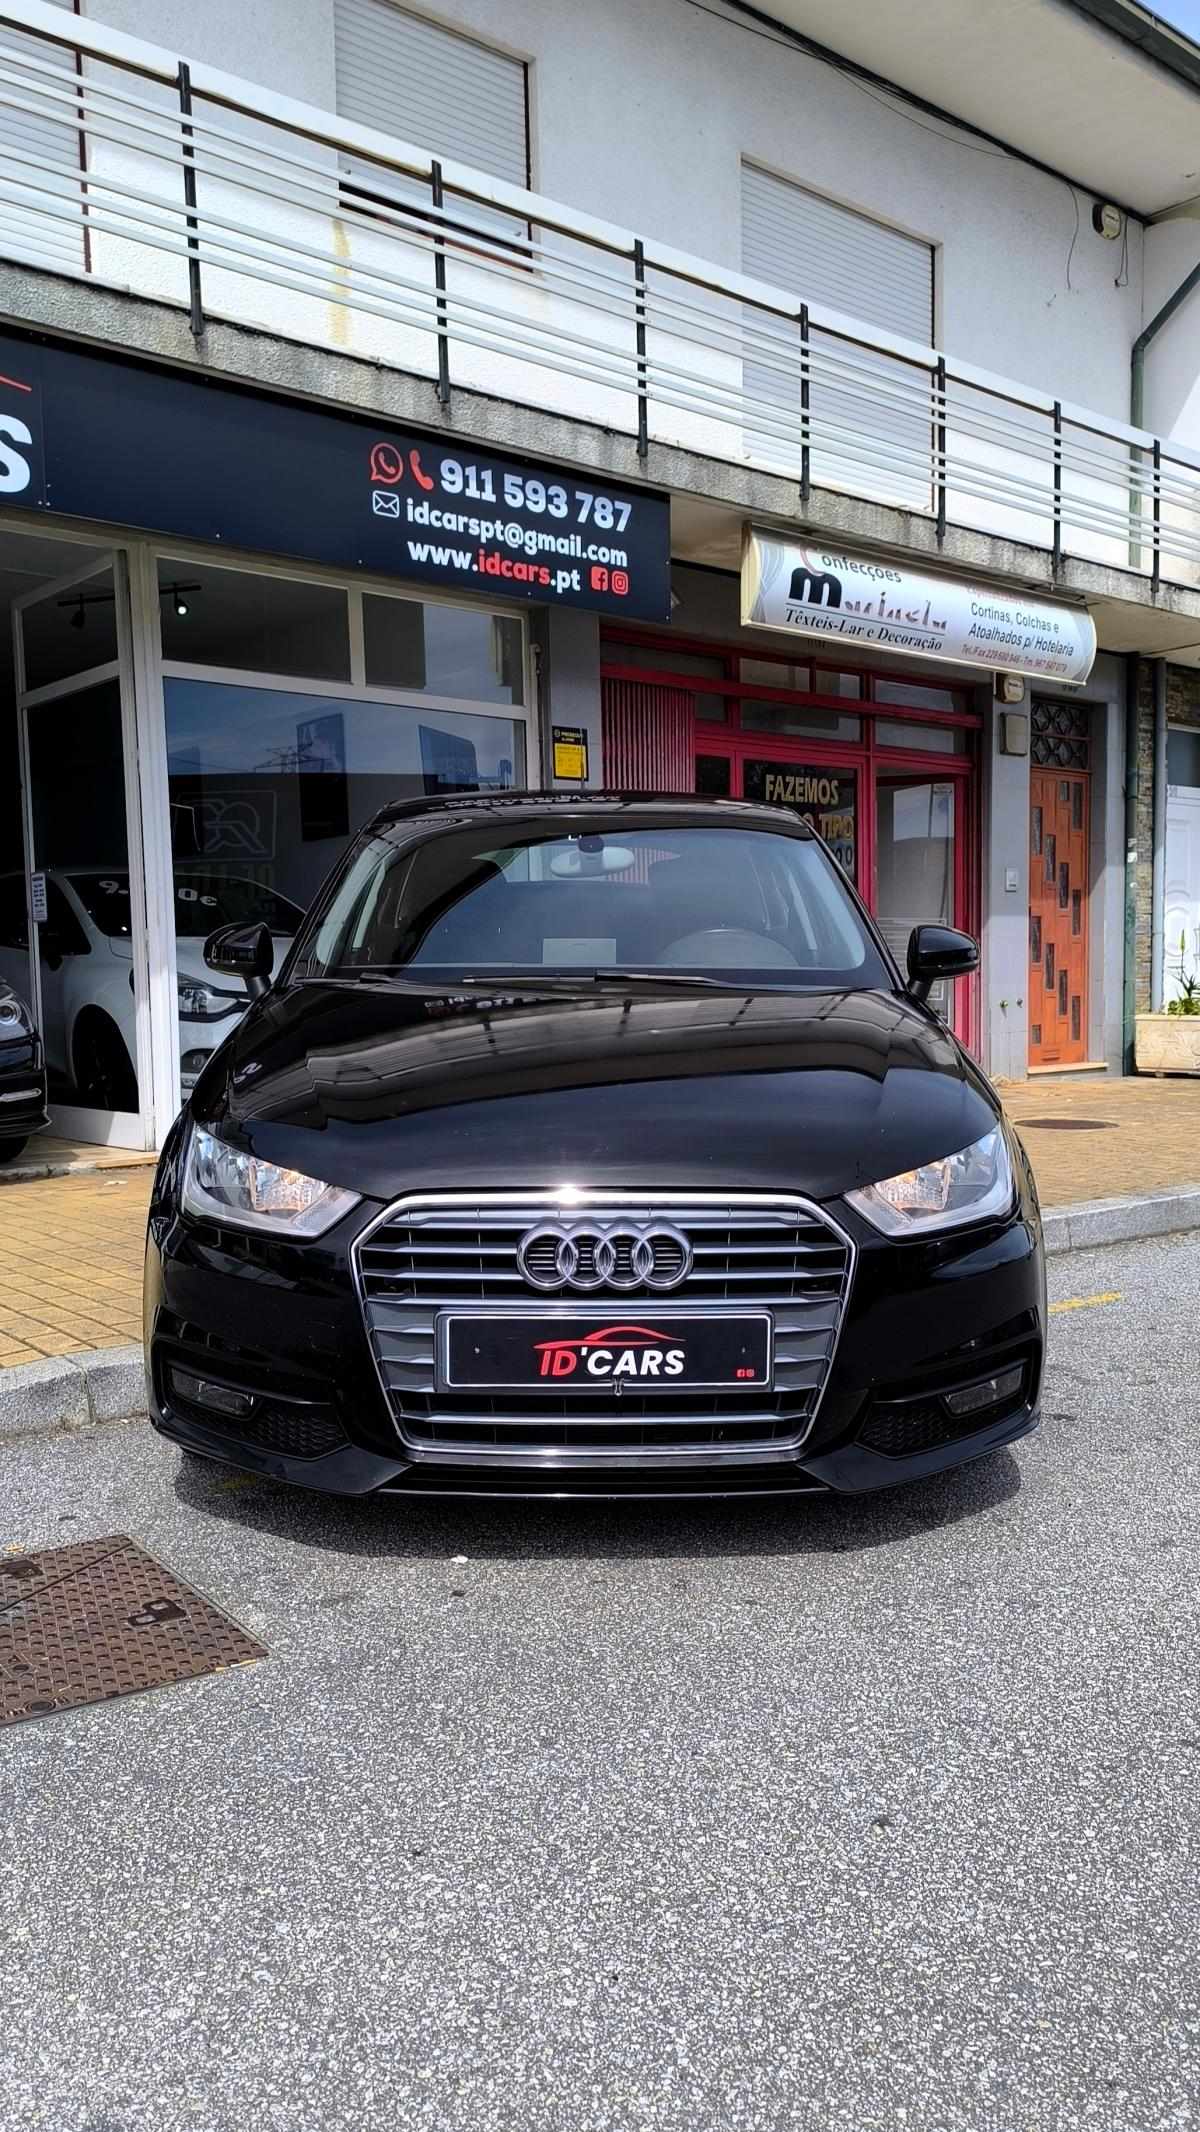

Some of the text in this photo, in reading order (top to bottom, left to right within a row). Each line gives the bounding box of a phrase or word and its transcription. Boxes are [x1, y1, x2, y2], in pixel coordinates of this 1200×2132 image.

[440, 459, 632, 532] 911 593 787
[406, 498, 628, 567] idcarspt@gmail.com
[407, 541, 581, 593] www.idcars.pt
[785, 608, 942, 650] Têxteis-Lar e Decoração
[971, 602, 1059, 633] Cortinas, Colchas e
[968, 623, 1022, 646] Atoalhados
[1035, 639, 1074, 656] Hotelaria
[766, 774, 840, 805] FAZEMOS
[819, 814, 854, 840] TIPO
[540, 1347, 685, 1376] ID'CARS
